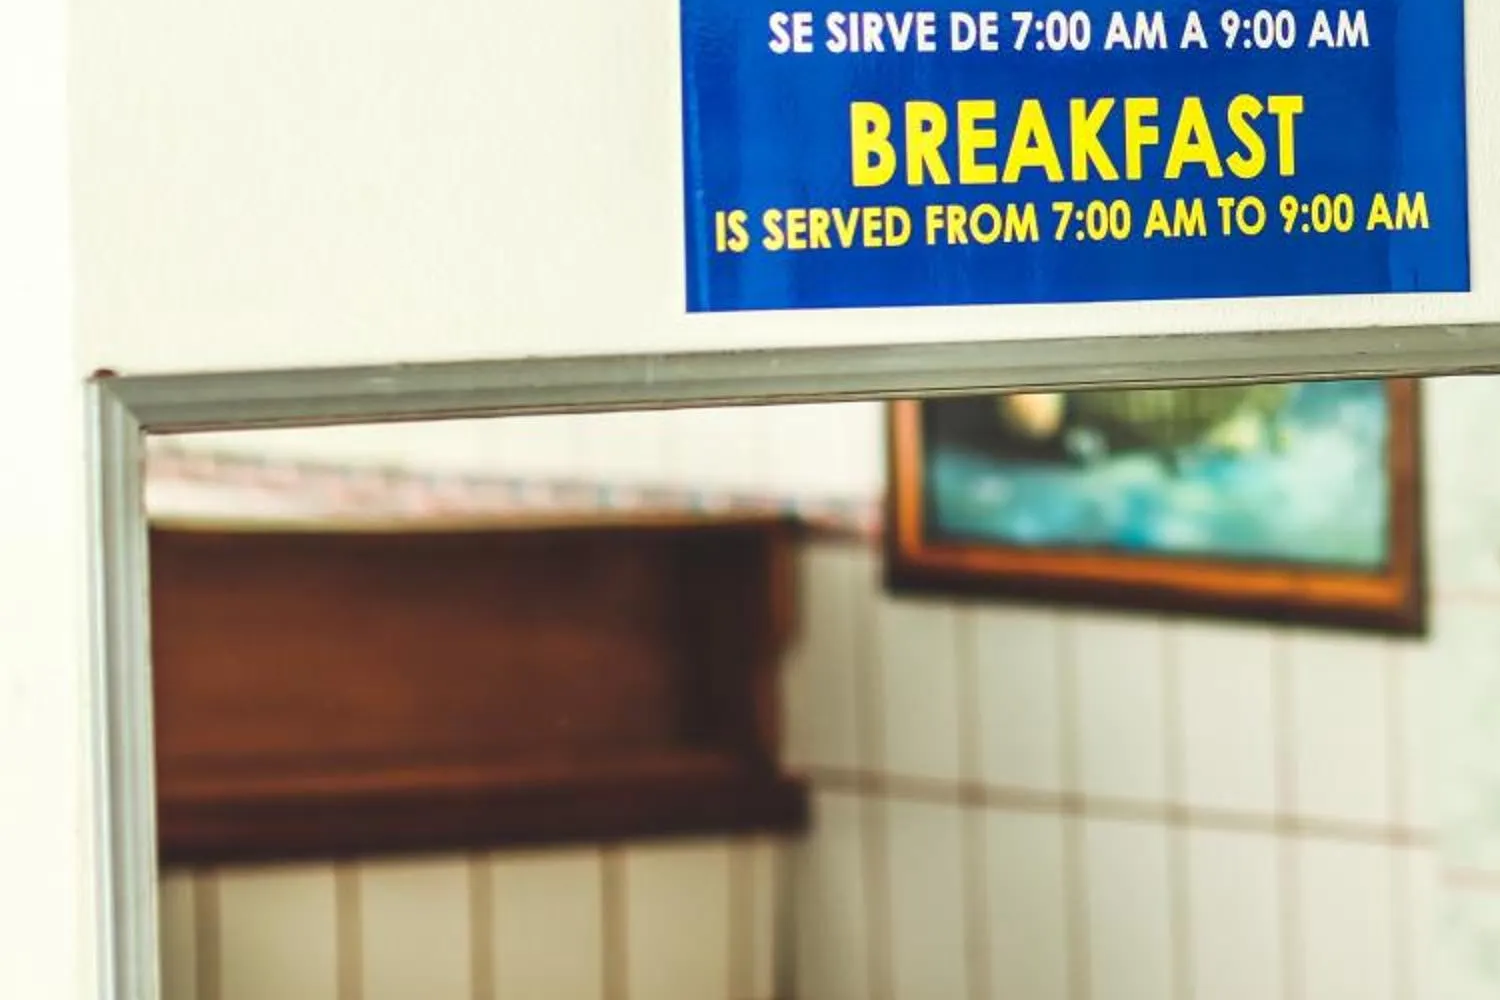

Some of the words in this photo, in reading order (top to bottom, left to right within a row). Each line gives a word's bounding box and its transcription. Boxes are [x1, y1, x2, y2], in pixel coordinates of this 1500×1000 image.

[768, 11, 813, 54] SE
[825, 11, 937, 54] SIRVE
[950, 11, 1000, 52] DE
[1011, 10, 1091, 52] 7:00
[1103, 10, 1168, 51] AM
[1179, 10, 1209, 50] A
[1220, 9, 1296, 50] 9:00
[1308, 9, 1370, 49] AM
[849, 93, 1305, 188] BREAKFAST
[715, 209, 750, 254] IS
[762, 206, 912, 253] SERVED
[925, 202, 1039, 247] FROM
[1051, 199, 1132, 242] 7:00
[1143, 197, 1207, 240] AM
[1217, 195, 1267, 237] TO
[1279, 193, 1354, 235] 9:00
[1366, 191, 1430, 232] AM
